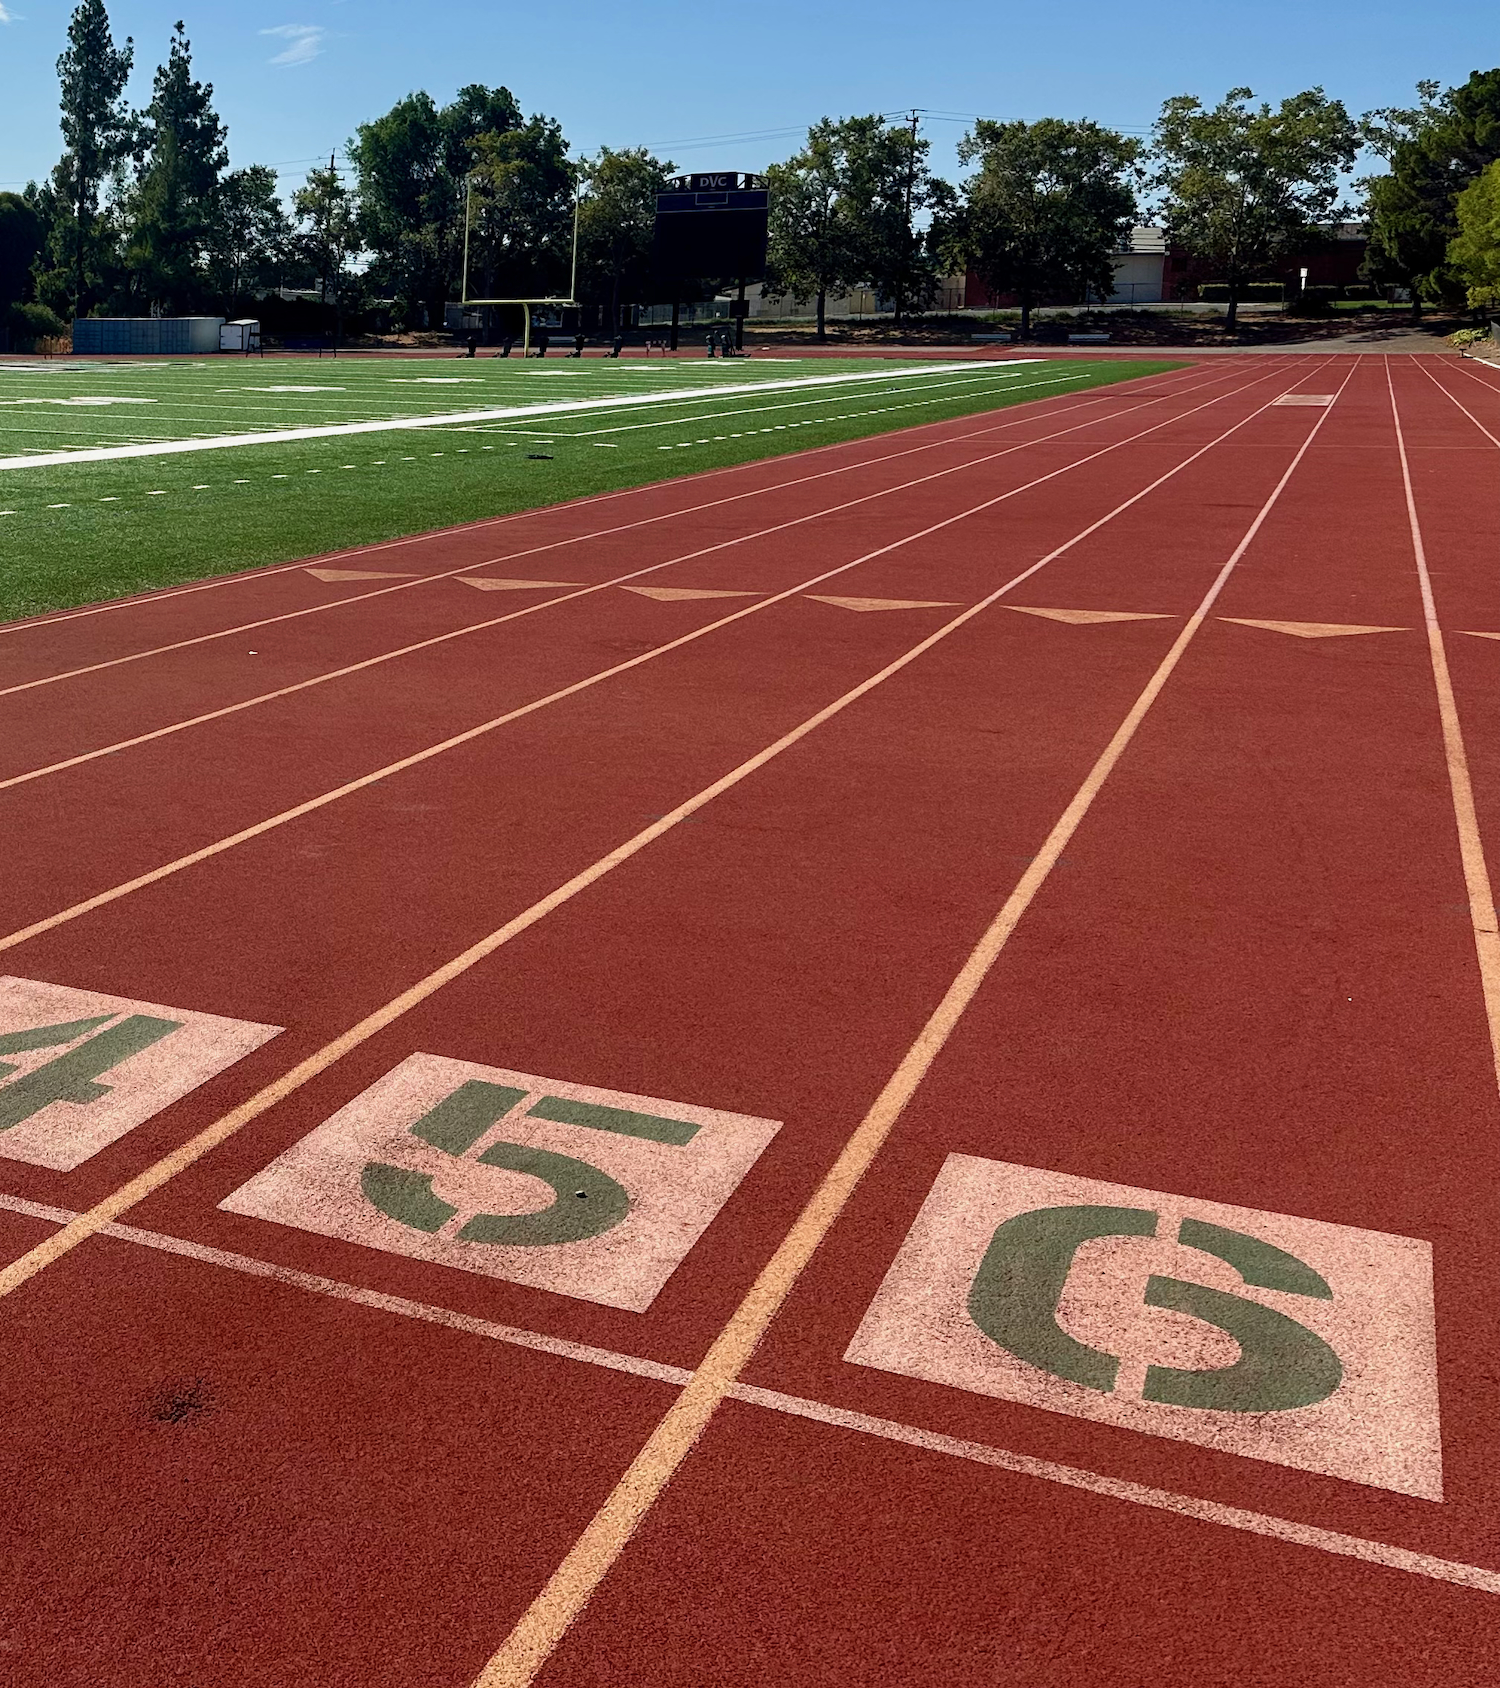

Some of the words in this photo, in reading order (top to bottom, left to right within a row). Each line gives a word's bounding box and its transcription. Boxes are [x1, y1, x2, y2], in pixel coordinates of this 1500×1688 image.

[700, 175, 728, 188] DVC
[359, 1078, 703, 1247] 5
[966, 1204, 1345, 1412] 6
